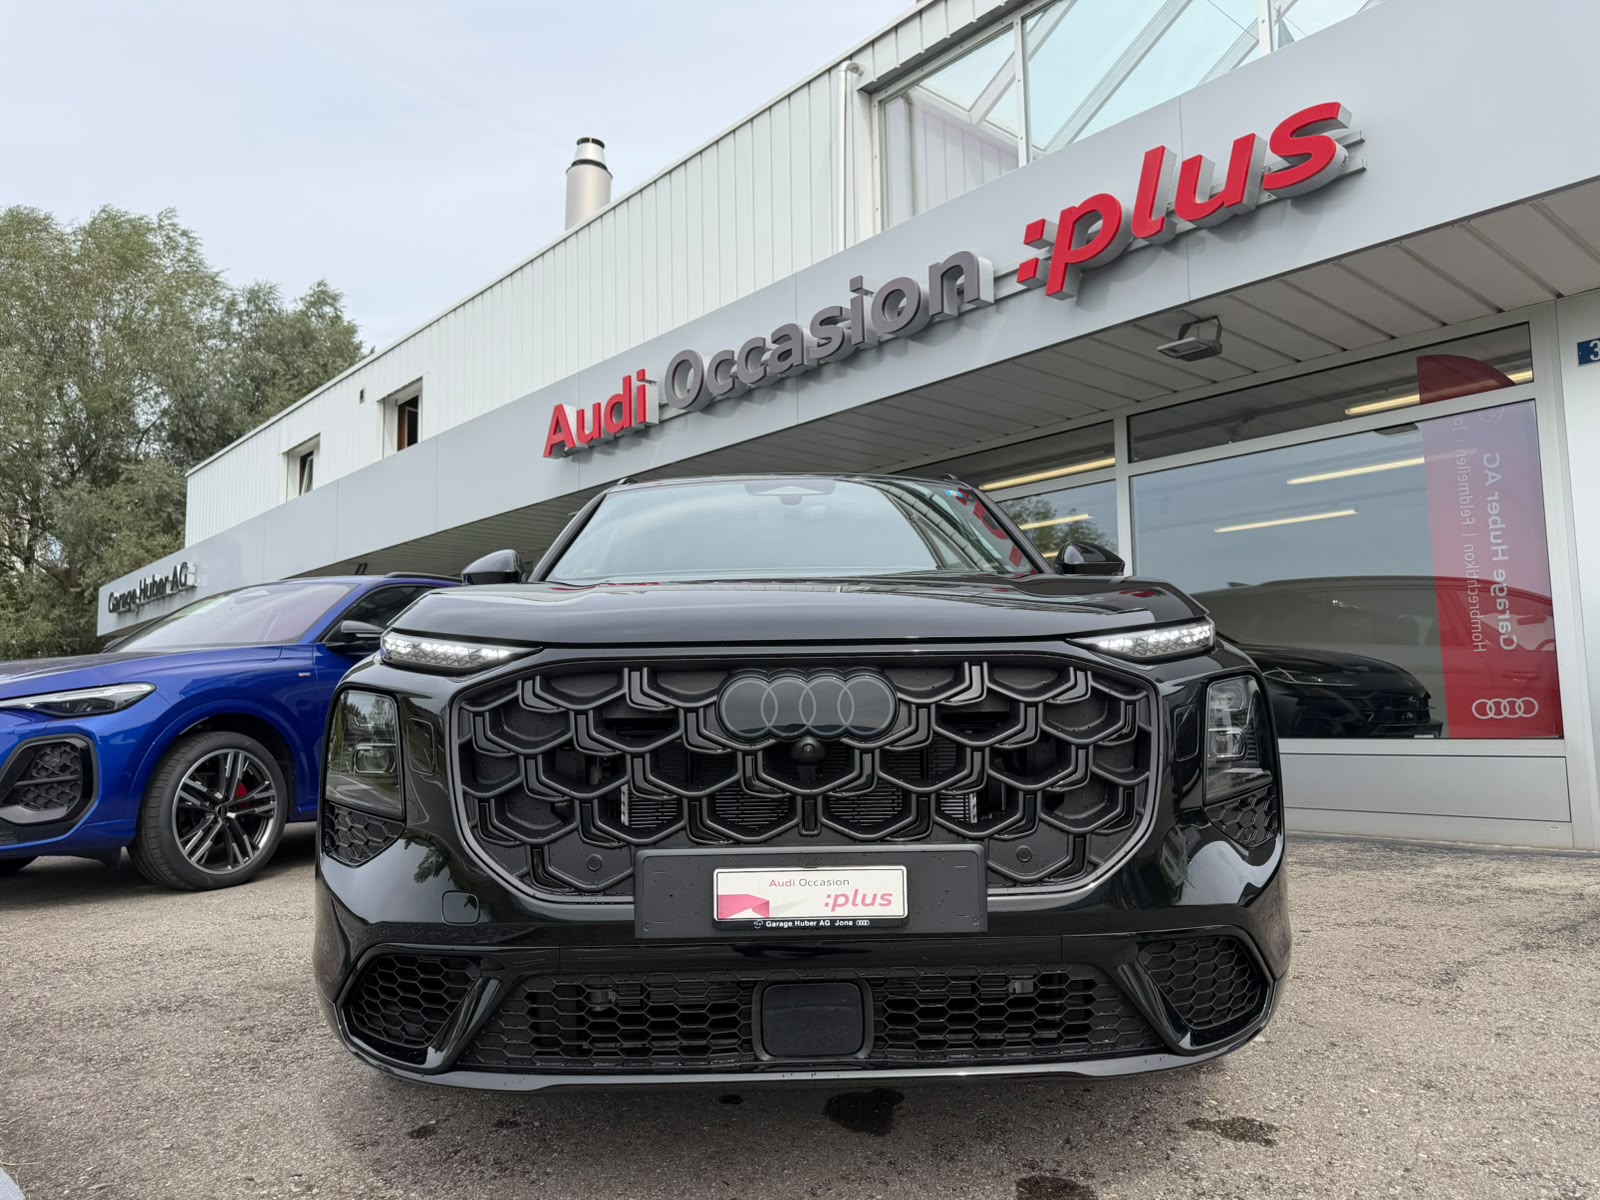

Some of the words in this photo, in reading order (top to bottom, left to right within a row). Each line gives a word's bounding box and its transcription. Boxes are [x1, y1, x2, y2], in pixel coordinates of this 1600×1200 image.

[543, 368, 650, 458] Audi
[664, 250, 984, 411] Occasion
[1017, 101, 1348, 298] :plus
[108, 590, 138, 613] Garage
[139, 574, 169, 602] Huber
[171, 561, 188, 591] AG
[768, 879, 796, 888] Audi
[798, 877, 850, 887] Occasion
[824, 888, 894, 912] :plus
[765, 920, 793, 929] Garage
